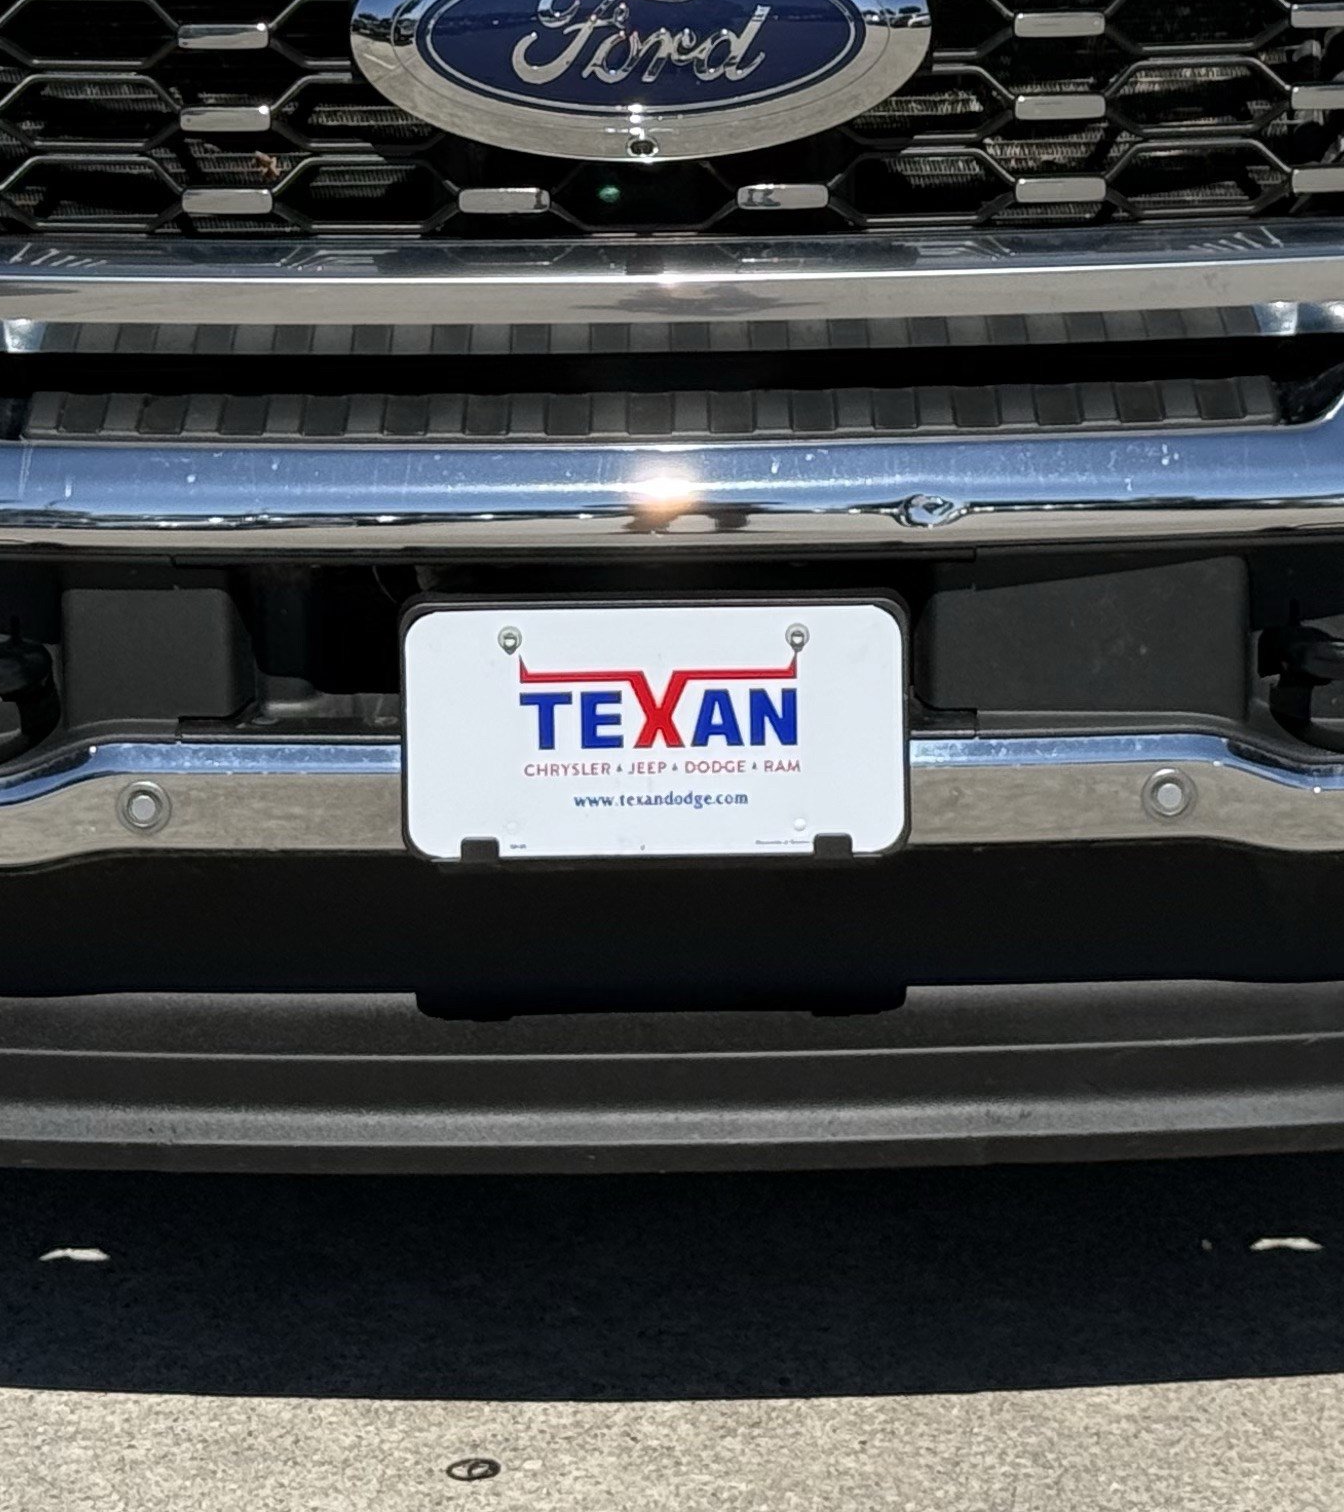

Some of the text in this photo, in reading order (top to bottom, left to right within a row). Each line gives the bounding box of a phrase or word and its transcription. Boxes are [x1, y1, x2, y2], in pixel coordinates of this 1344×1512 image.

[519, 665, 799, 750] TEXAN
[523, 758, 801, 778] CHRYSLER JEEP DODGE RAM
[572, 790, 749, 809] www.texandodge.com
